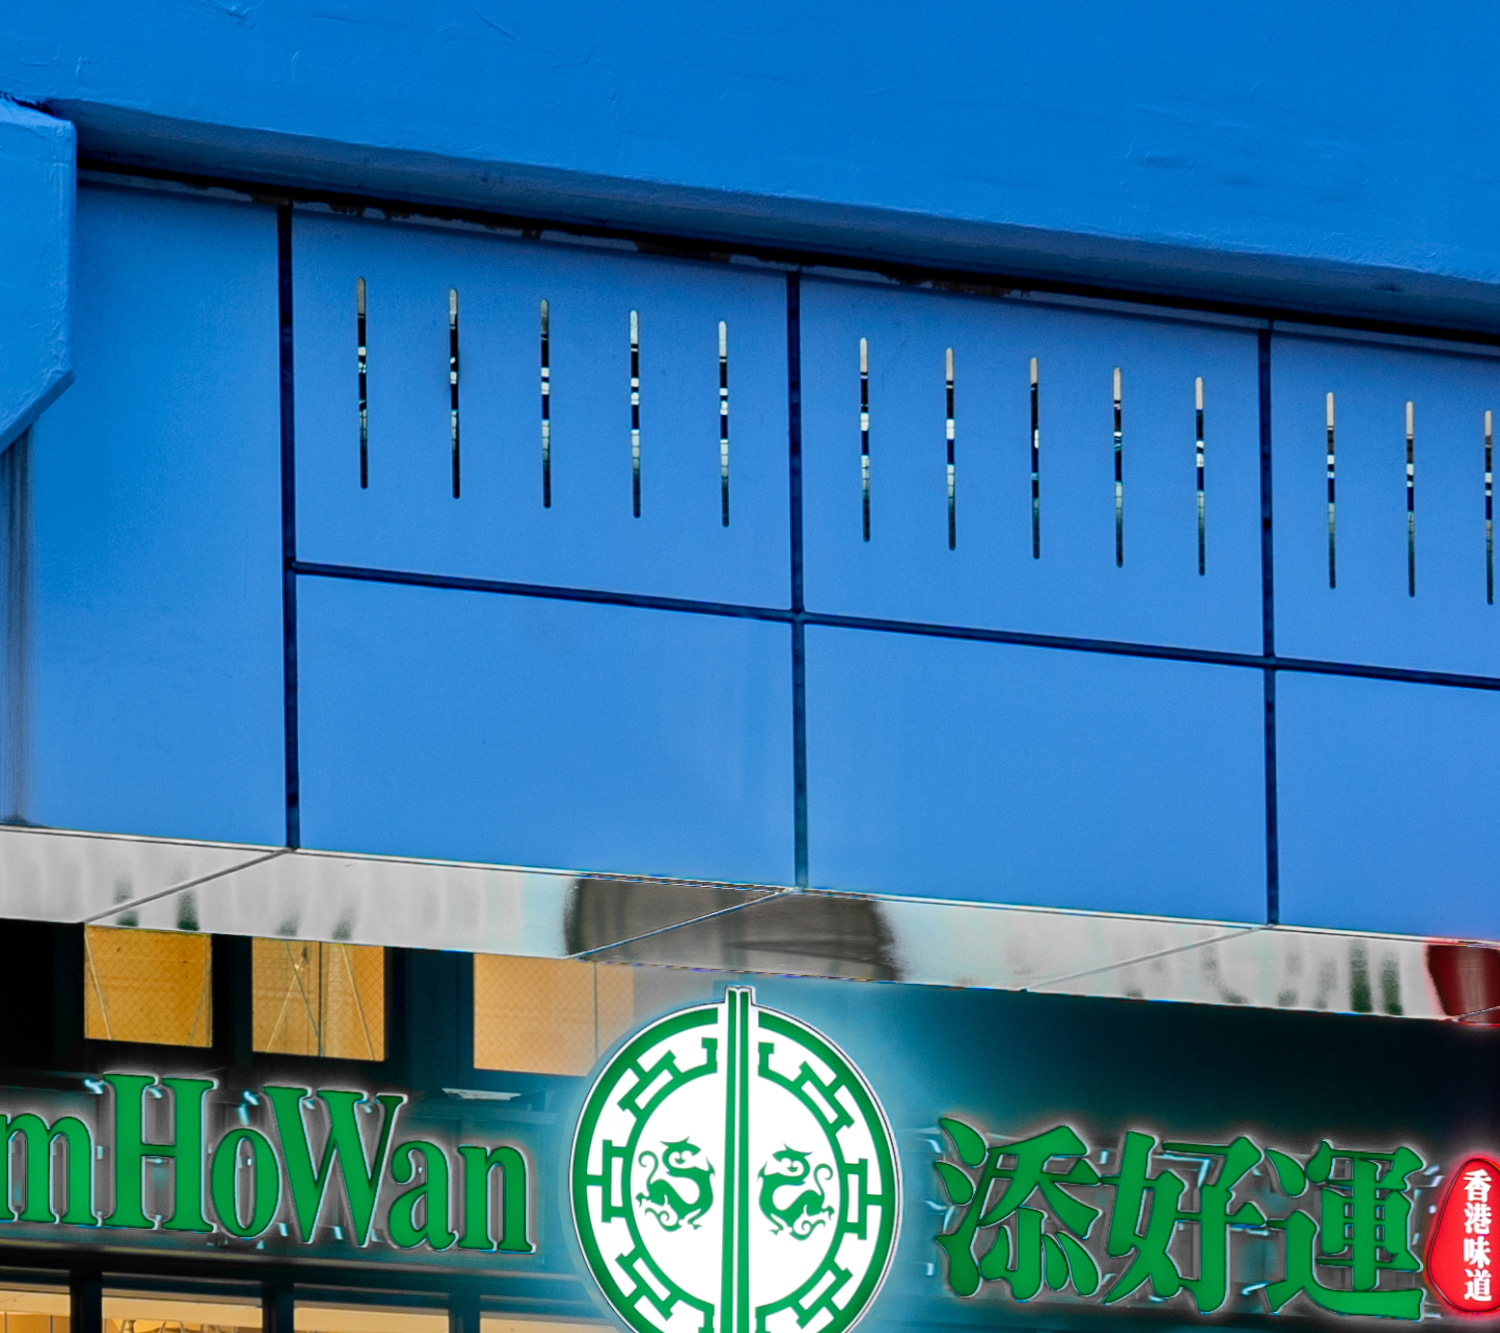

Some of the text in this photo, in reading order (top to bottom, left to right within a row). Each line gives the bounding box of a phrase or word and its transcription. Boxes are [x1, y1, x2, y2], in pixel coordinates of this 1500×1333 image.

[933, 1117, 1426, 1321] 添好運
[1462, 1168, 1493, 1303] 香港味道
